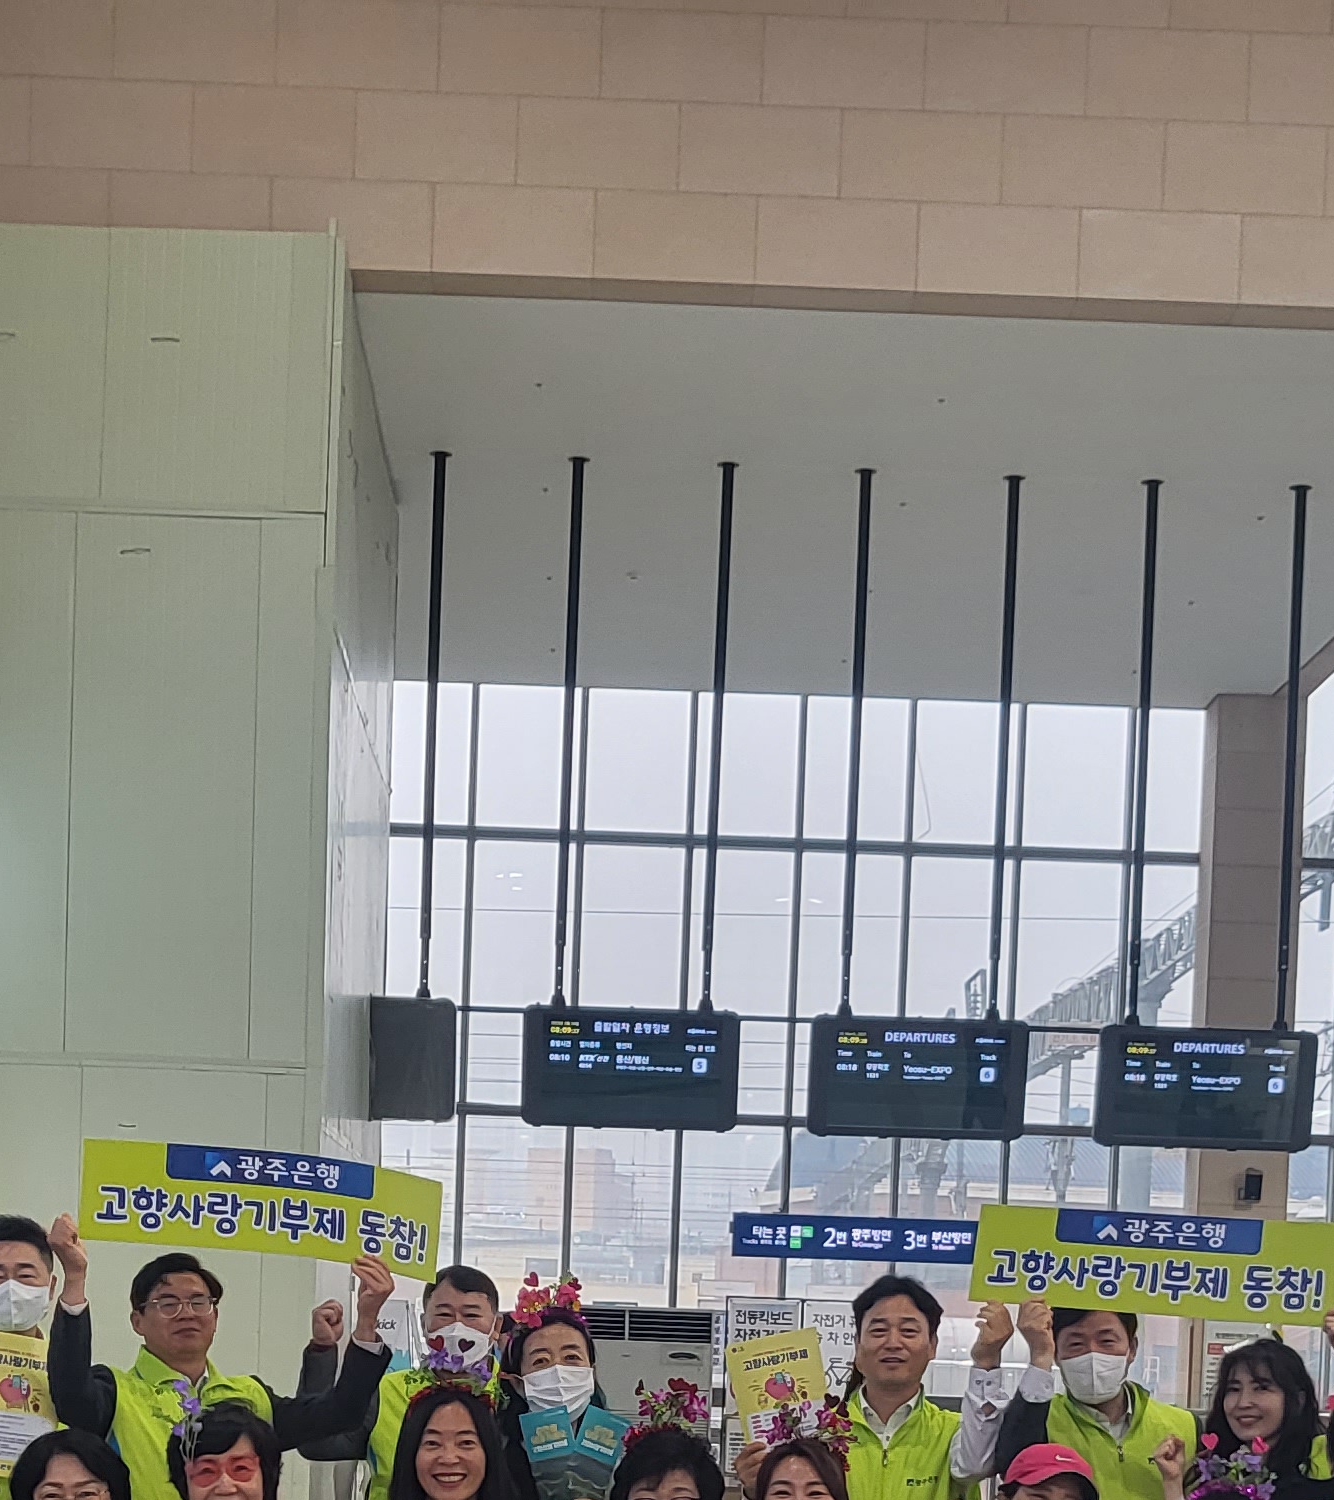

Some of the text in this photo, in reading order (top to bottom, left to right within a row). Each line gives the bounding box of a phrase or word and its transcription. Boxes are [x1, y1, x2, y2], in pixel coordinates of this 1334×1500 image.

[884, 1031, 956, 1044] DEPARTURES
[1173, 1042, 1246, 1055] DEPARTURES
[236, 1154, 341, 1190] 광주은행
[95, 1184, 429, 1264] 고향사랑기부제 동참!
[1123, 1218, 1227, 1248] 광주은행
[823, 1228, 847, 1247] 2번
[903, 1230, 971, 1250] 3번 부산방면
[987, 1249, 1325, 1310] 고향사랑기부제 동참!
[735, 1309, 793, 1326] 전동킥보드
[812, 1313, 845, 1328] 자전거
[742, 1348, 809, 1372] 고향사랑기부제
